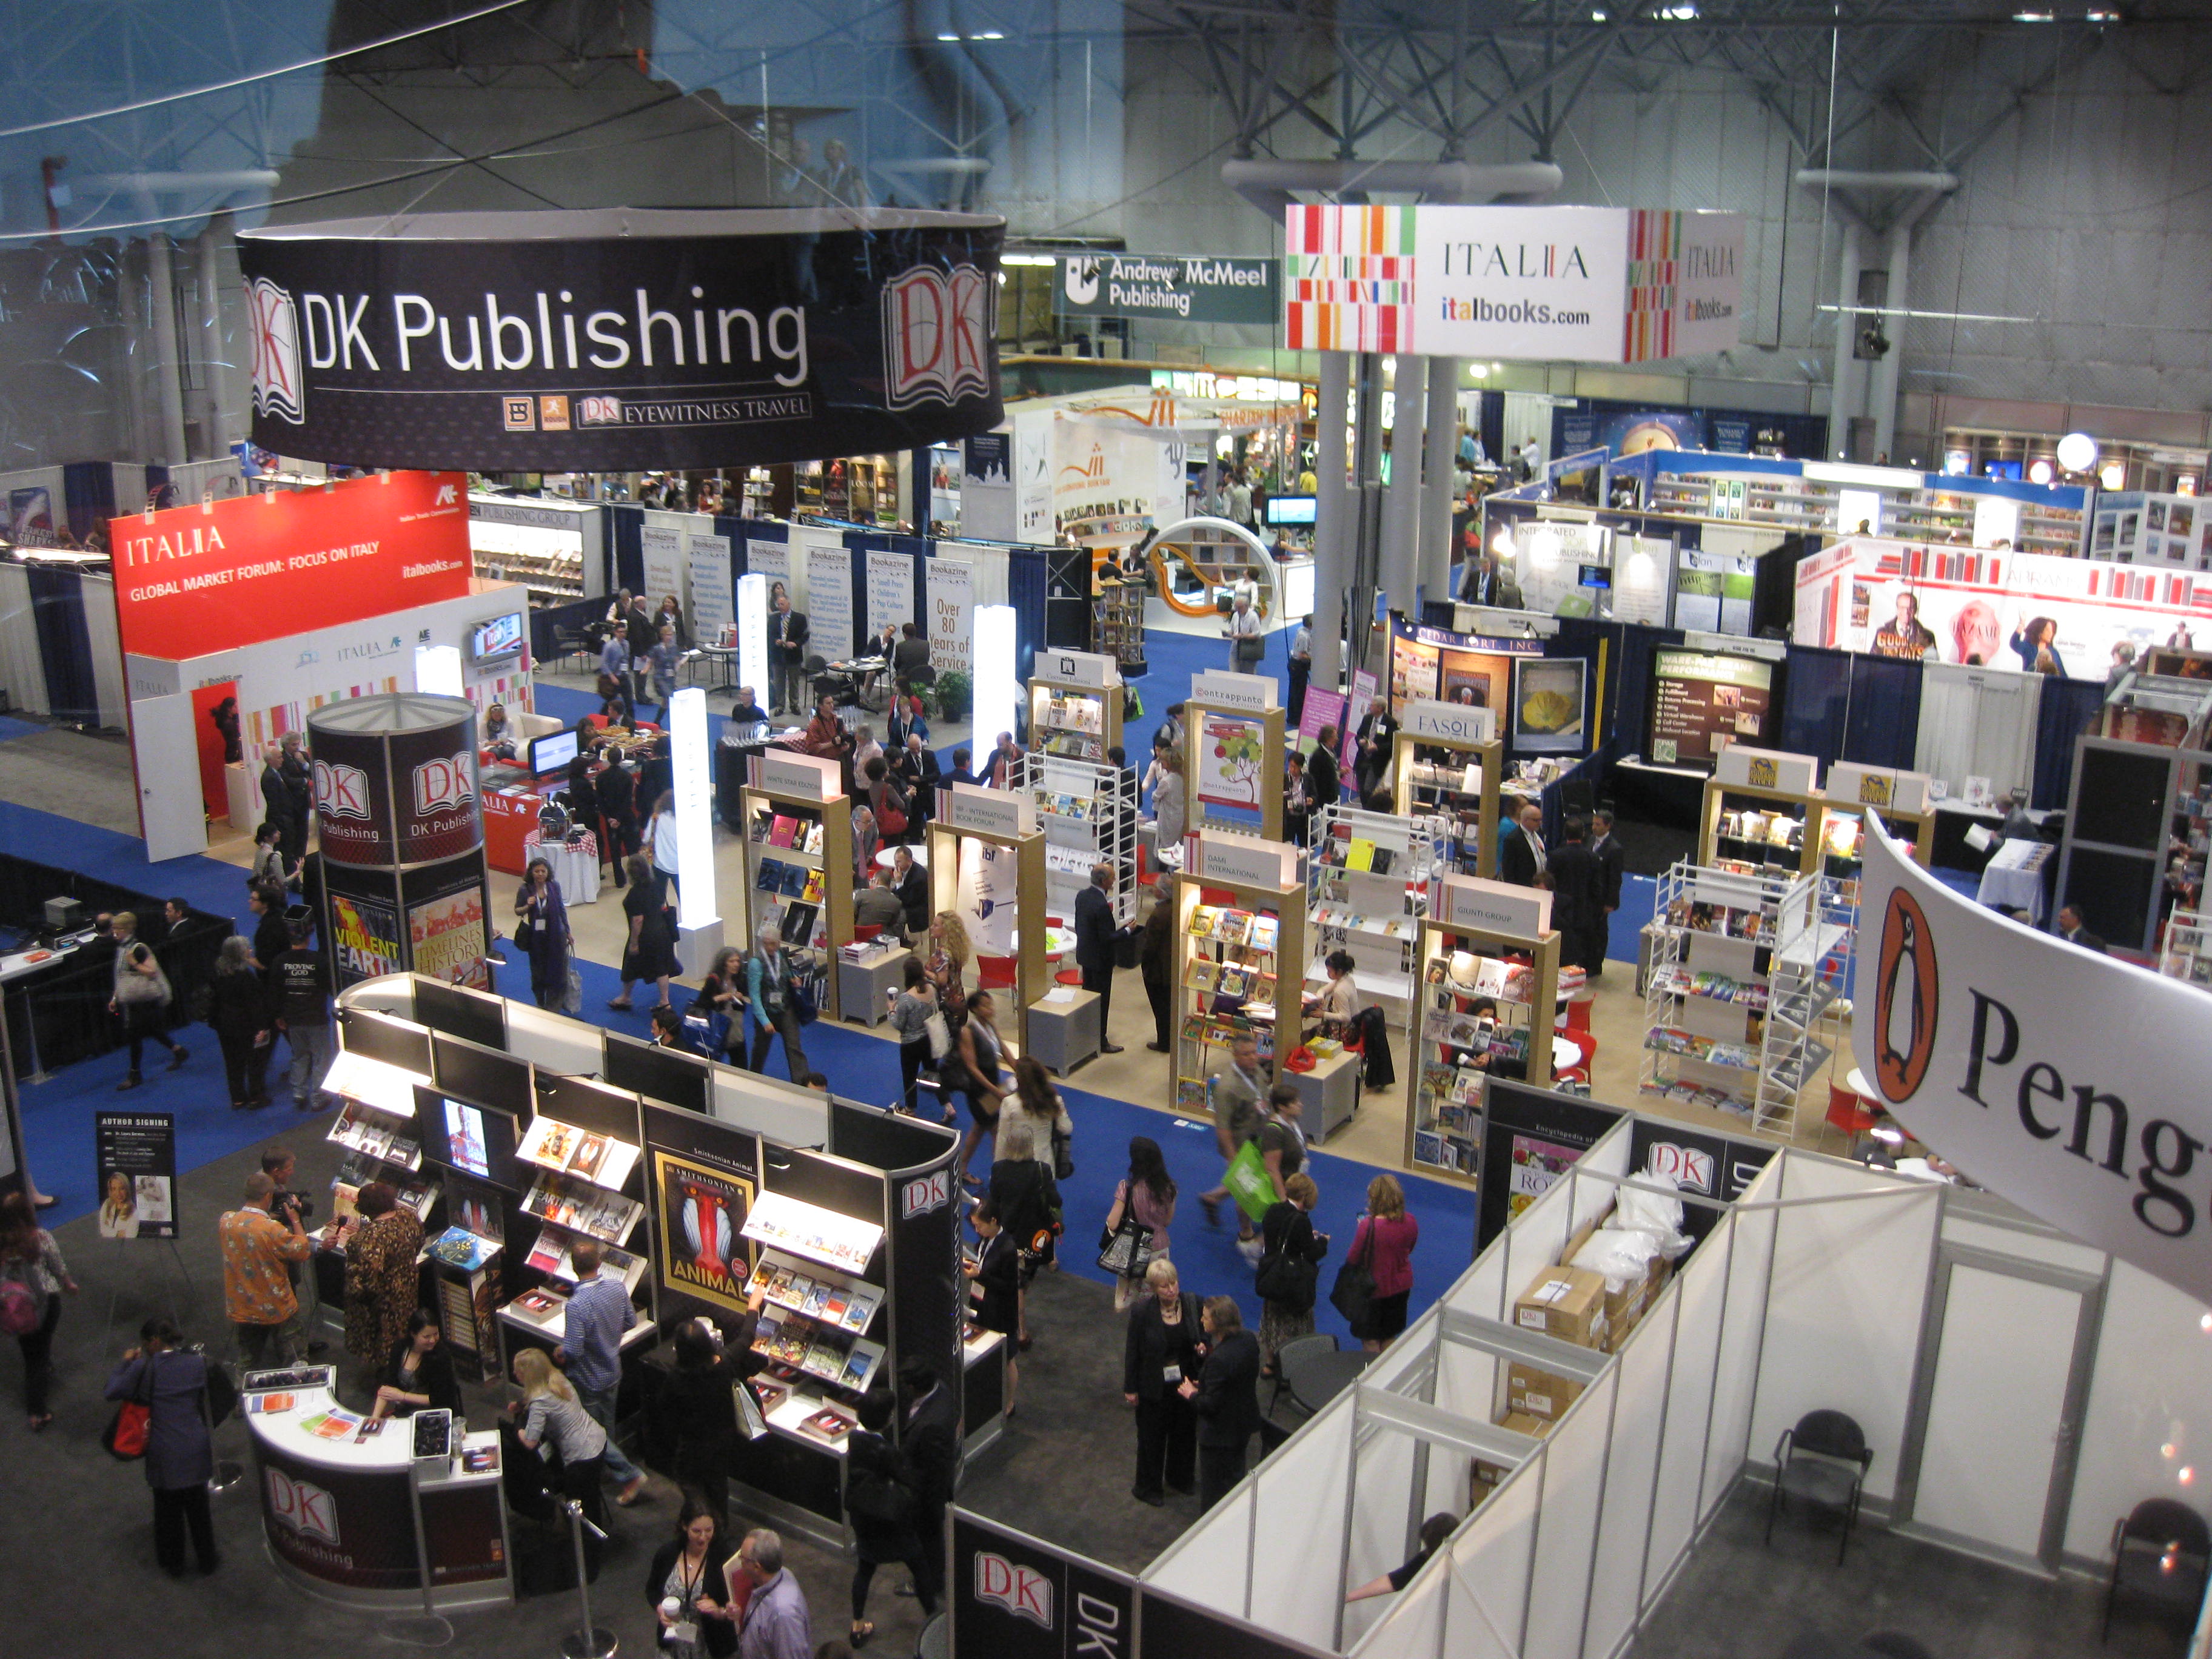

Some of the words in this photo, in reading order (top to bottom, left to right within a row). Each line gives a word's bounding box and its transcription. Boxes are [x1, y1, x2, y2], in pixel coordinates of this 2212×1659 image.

[1109, 257, 1179, 282] Andrew
[1185, 260, 1267, 286] McMeel
[1443, 243, 1588, 279] ITALIA
[1687, 244, 1734, 279] ITALIA
[1109, 283, 1190, 317] Publishing
[1442, 296, 1590, 326] italbooks.com
[304, 293, 380, 372] DK
[394, 285, 808, 388] Publishing
[896, 276, 982, 385] DK
[585, 398, 618, 419] DK
[624, 403, 740, 423] EYEWITNESS
[744, 397, 808, 418] TRAVEL
[484, 504, 535, 523] PUBLISHING
[537, 512, 570, 526] GROUP
[1518, 526, 1576, 537] INTEATED
[127, 525, 226, 566] ITALIA
[810, 551, 848, 563] Bookazine
[130, 580, 181, 602] GLOBAL
[183, 568, 235, 592] MARKET
[237, 559, 285, 581] FORUM:
[289, 552, 327, 572] FOCUS
[330, 548, 348, 562] ON
[350, 540, 380, 558] ITALY
[403, 559, 463, 580] italbooks.com
[870, 557, 909, 569] Bookazine
[931, 563, 968, 577] Bookazine
[936, 598, 961, 618] Over
[942, 617, 956, 633] 80
[928, 632, 956, 652] Years
[959, 636, 970, 654] of
[1418, 627, 1456, 644] CEDAR
[1509, 640, 1541, 651] INC.
[337, 642, 381, 662] ITALIA
[930, 651, 967, 671] Service
[1419, 716, 1479, 739] FASOLI
[315, 764, 363, 811] DK
[421, 757, 472, 806] DK
[766, 776, 783, 784] WHITE
[482, 794, 509, 811] ALIA
[956, 814, 972, 823] BOOK
[974, 817, 995, 827] FORUM
[970, 808, 1014, 823] INTERNATIONAL
[322, 821, 379, 843] Publishing
[411, 822, 430, 837] DK
[982, 846, 996, 862] ibf
[1207, 854, 1227, 865] DAMI
[1207, 863, 1260, 880] INTERNATIONAL
[1458, 905, 1484, 918] GIUNTI
[1485, 911, 1512, 923] GROUP
[335, 927, 398, 960] VIOLENT
[415, 927, 481, 958] TIMELINES
[283, 963, 316, 971] PROVING
[419, 943, 481, 973] HISTORY
[1957, 985, 2212, 1238] Peng
[1535, 1124, 1583, 1141] Encyclopedia
[694, 1147, 731, 1165] Smithsonian
[732, 1159, 753, 1172] Animal
[1656, 1145, 1706, 1185] DK
[676, 1167, 736, 1193] SMITHSONIAN
[1520, 1174, 1552, 1193] RO
[909, 1175, 947, 1211] DK
[673, 1259, 749, 1299] ANIMAL
[271, 1472, 327, 1532] DK
[984, 1557, 1044, 1618] DK
[1076, 1592, 1119, 1659] DK
